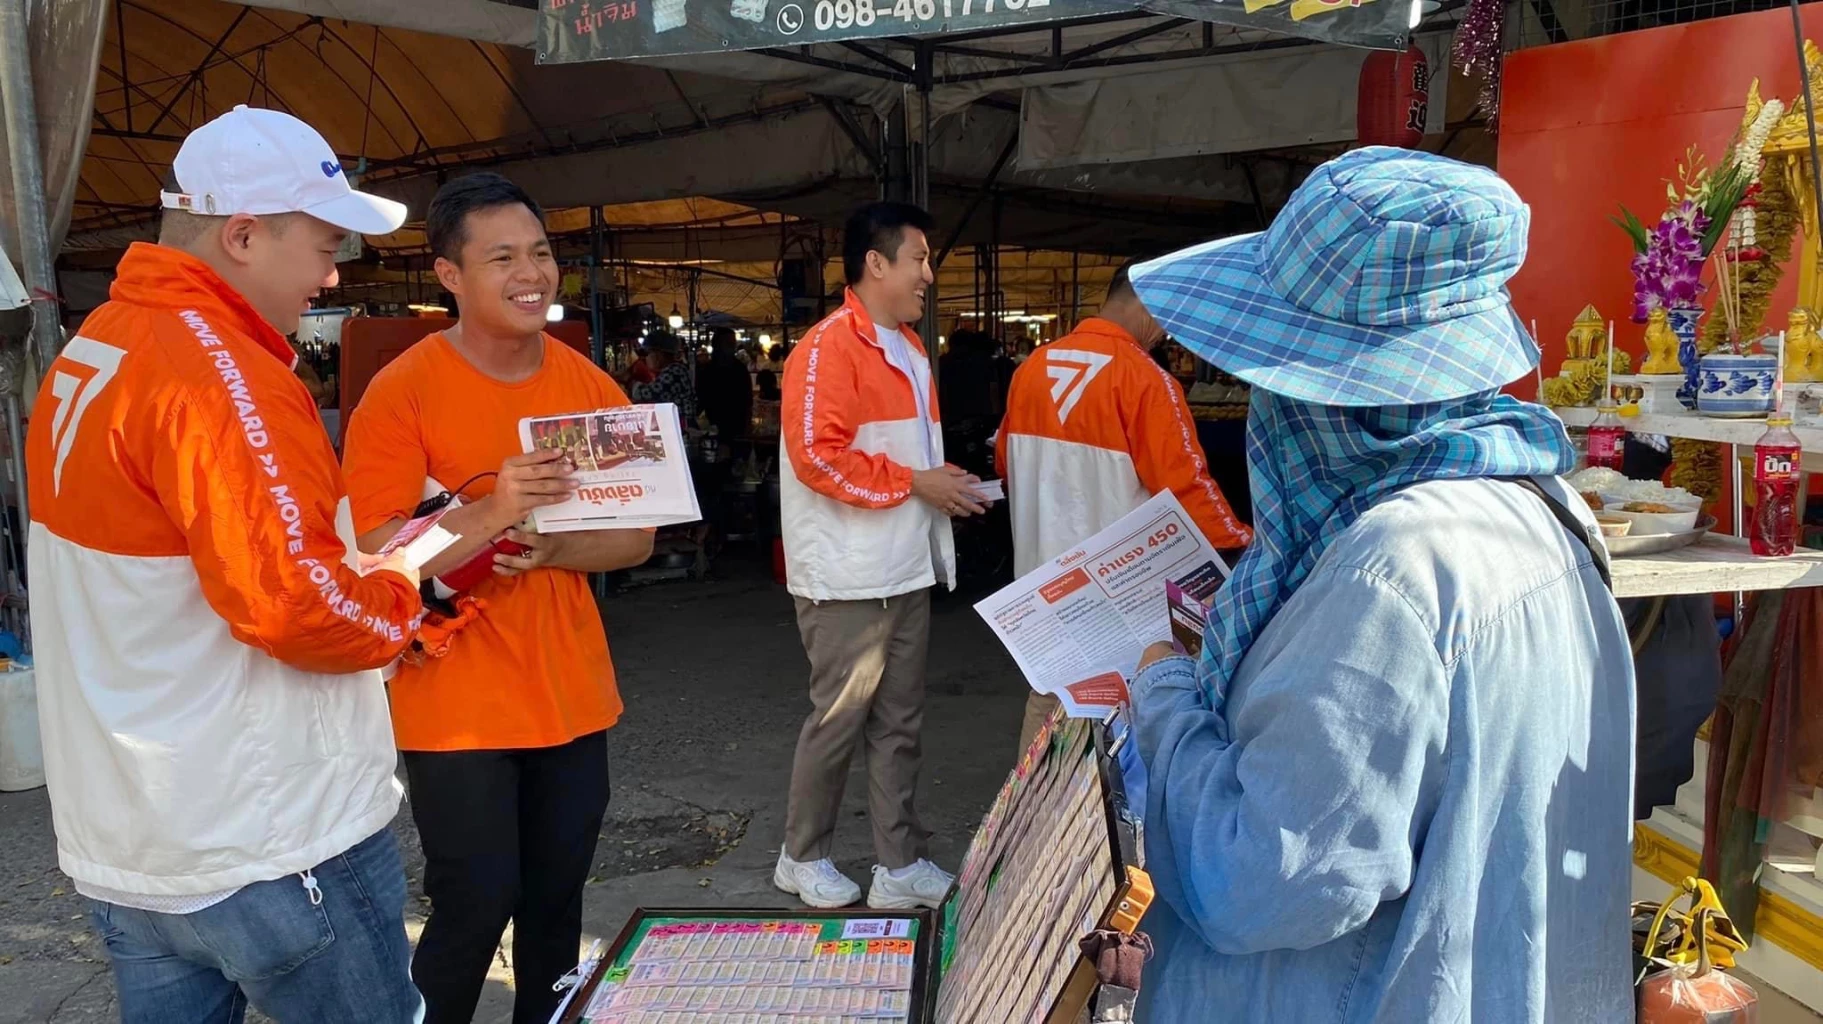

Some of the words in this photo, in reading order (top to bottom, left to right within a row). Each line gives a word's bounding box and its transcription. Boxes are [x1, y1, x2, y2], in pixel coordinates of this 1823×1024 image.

[806, 348, 820, 382] MOVE
[803, 385, 816, 446] FORWARD
[178, 309, 222, 348] MOVE
[208, 350, 269, 448] FORWARD
[270, 484, 304, 555] MOVE
[297, 558, 361, 622] FORWRD
[812, 457, 842, 484] MOVE
[1098, 546, 1144, 577] ค่าแรง
[1148, 523, 1178, 548] 450
